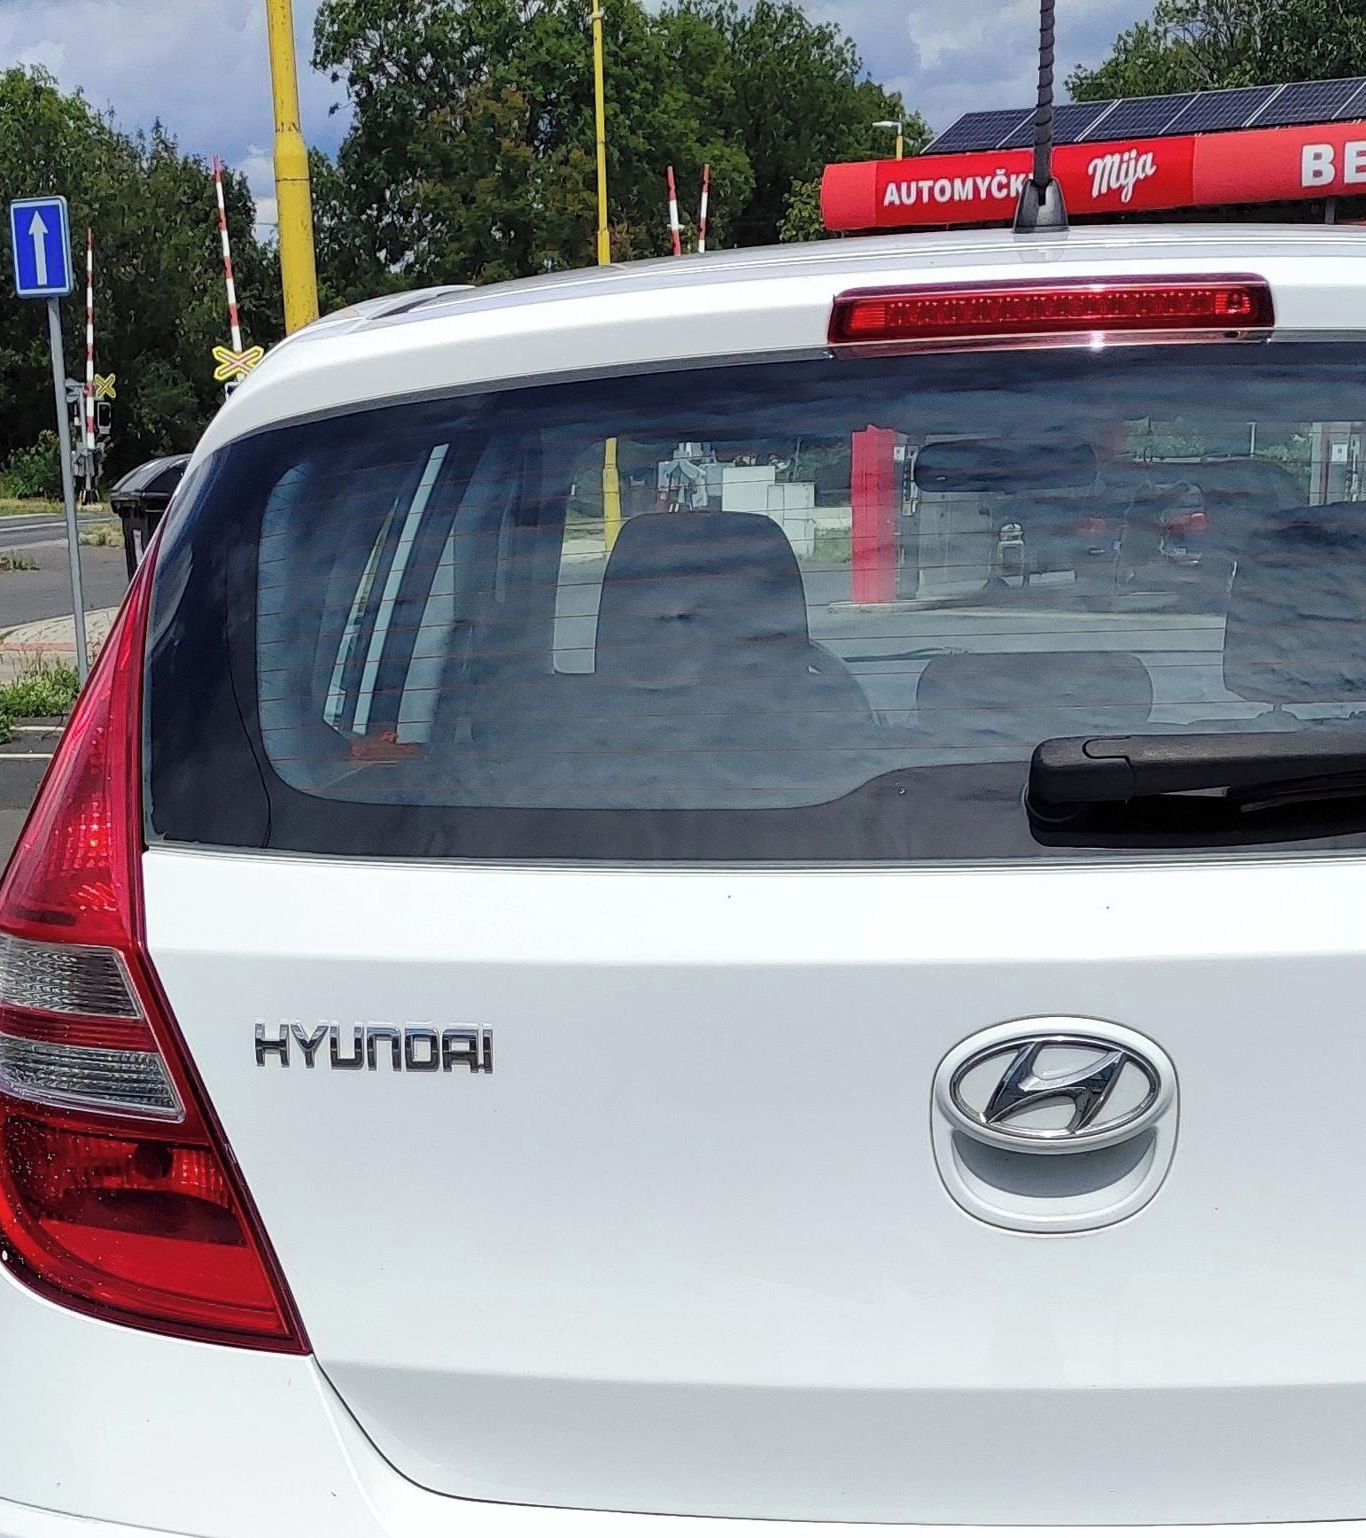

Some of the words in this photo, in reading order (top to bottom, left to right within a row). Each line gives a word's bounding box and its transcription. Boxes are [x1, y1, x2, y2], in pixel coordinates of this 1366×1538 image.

[883, 168, 1034, 206] AUTOMYČK
[1088, 149, 1156, 203] Mija
[254, 1019, 494, 1075] HYUNDAI
